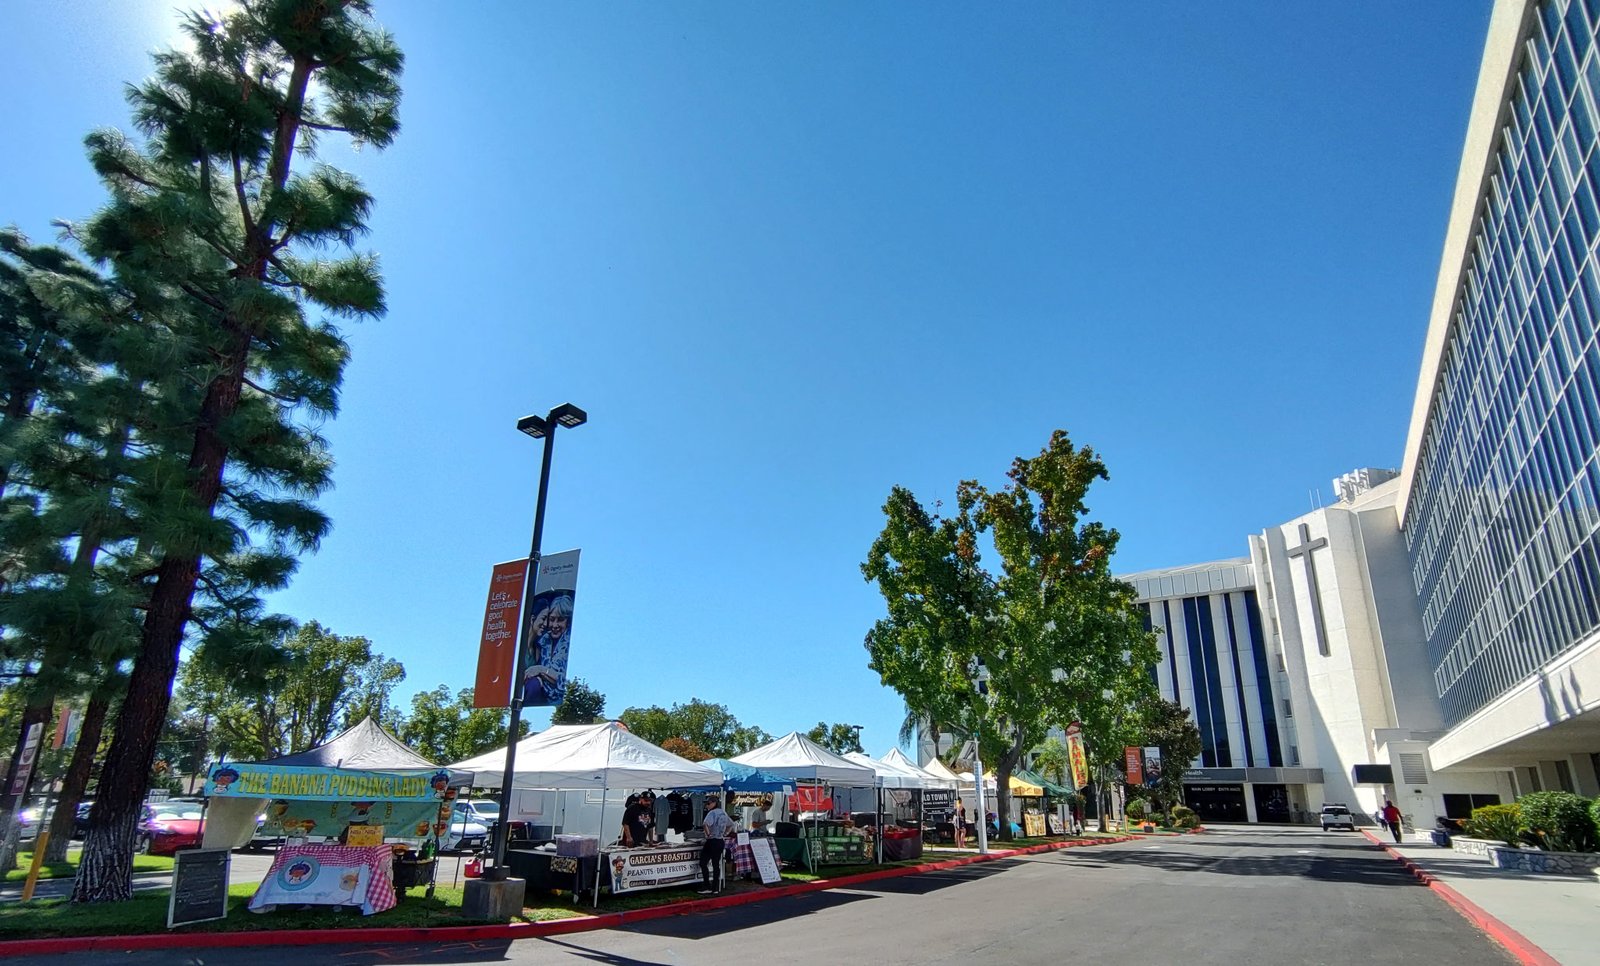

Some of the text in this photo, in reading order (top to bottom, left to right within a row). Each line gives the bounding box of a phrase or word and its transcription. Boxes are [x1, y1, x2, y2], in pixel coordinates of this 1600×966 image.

[490, 600, 517, 610] celebrate
[488, 609, 503, 621] good
[487, 619, 506, 630] health
[238, 771, 428, 797] THE BANANA PUDDING LADY
[931, 793, 948, 801] TOWN
[630, 854, 662, 865] GARCIA'S
[663, 852, 692, 863] ROASTED
[627, 867, 654, 877] PEANUTS
[656, 866, 669, 875] DRY
[669, 864, 687, 873] FRUITS
